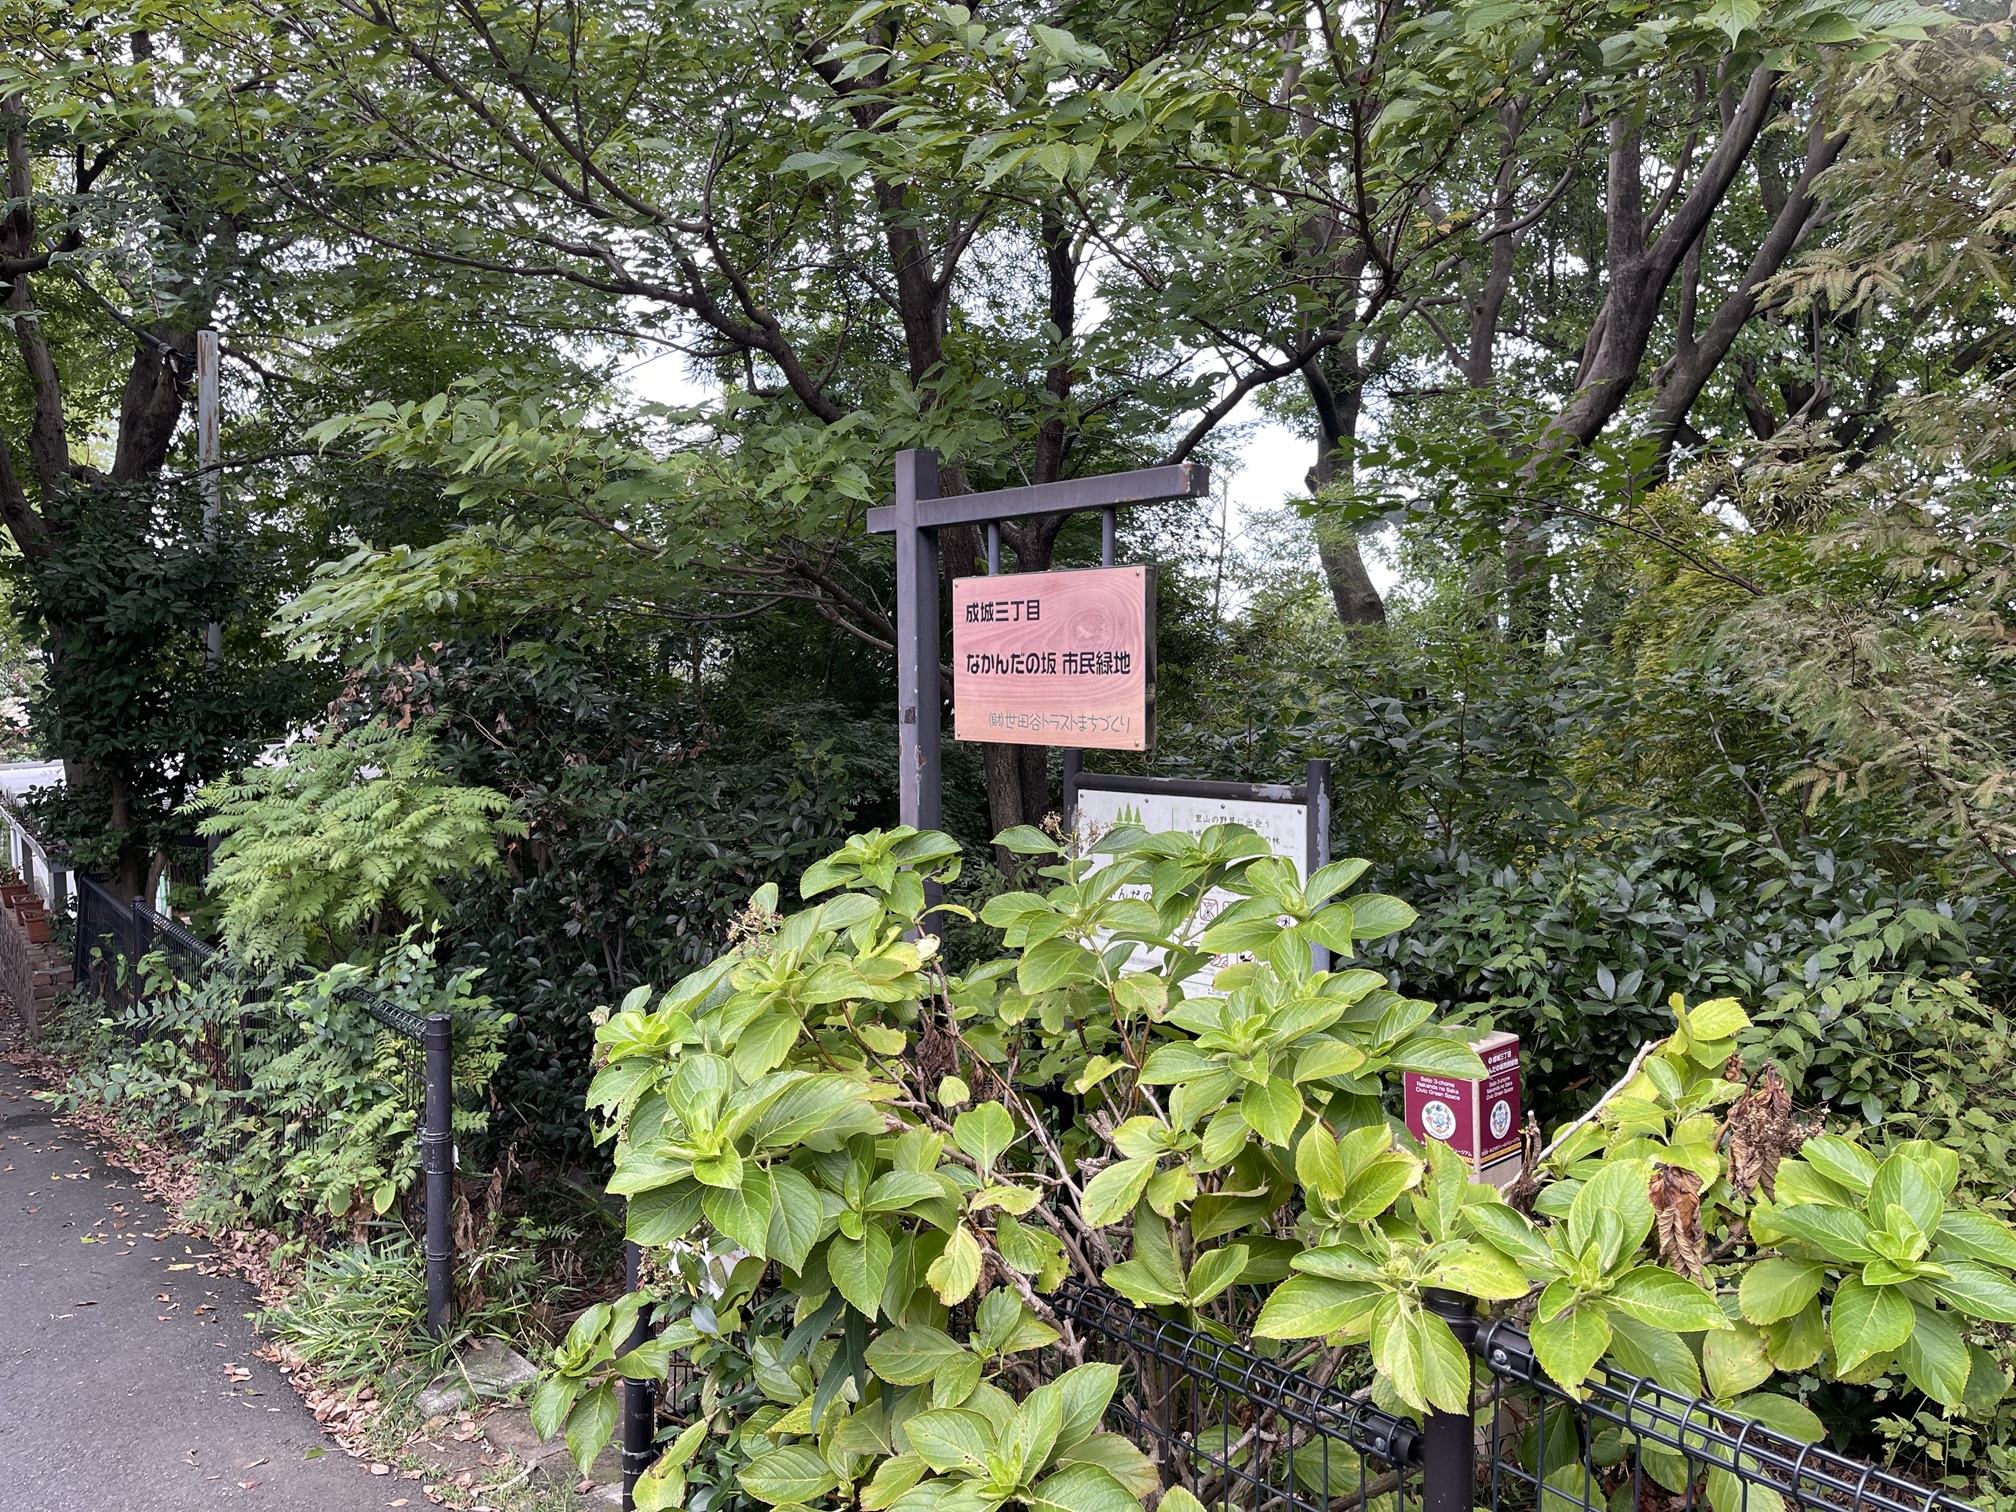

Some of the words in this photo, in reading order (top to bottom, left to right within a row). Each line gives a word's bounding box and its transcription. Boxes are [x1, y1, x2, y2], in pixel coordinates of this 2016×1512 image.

[966, 599, 1040, 623] 成城三丁目
[966, 652, 1057, 675] なかんだの坂
[1062, 651, 1131, 675] 市民緑地
